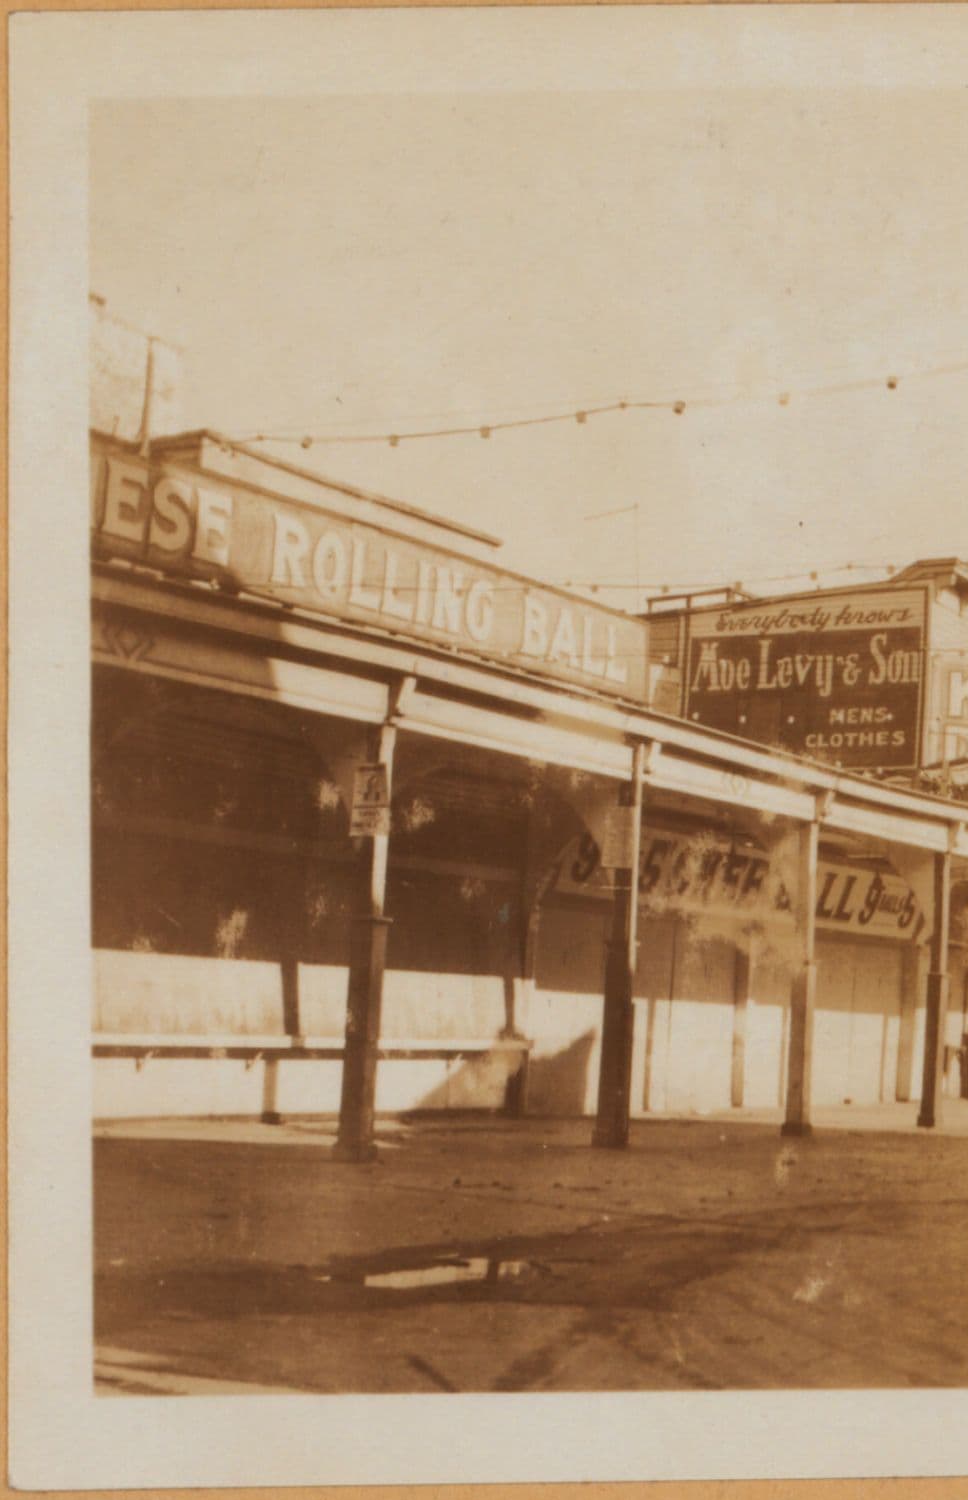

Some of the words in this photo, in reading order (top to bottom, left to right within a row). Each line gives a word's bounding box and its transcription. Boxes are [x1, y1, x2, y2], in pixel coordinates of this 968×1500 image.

[272, 513, 493, 642] ROLLING
[522, 594, 627, 683] BALL
[715, 606, 832, 637] Everybody
[834, 605, 912, 626] knows
[691, 641, 750, 692] Moe
[757, 639, 834, 697] Levy
[841, 652, 862, 686] &
[868, 632, 922, 685] Son
[829, 707, 888, 725] MENS
[805, 731, 906, 749] CLOTHES
